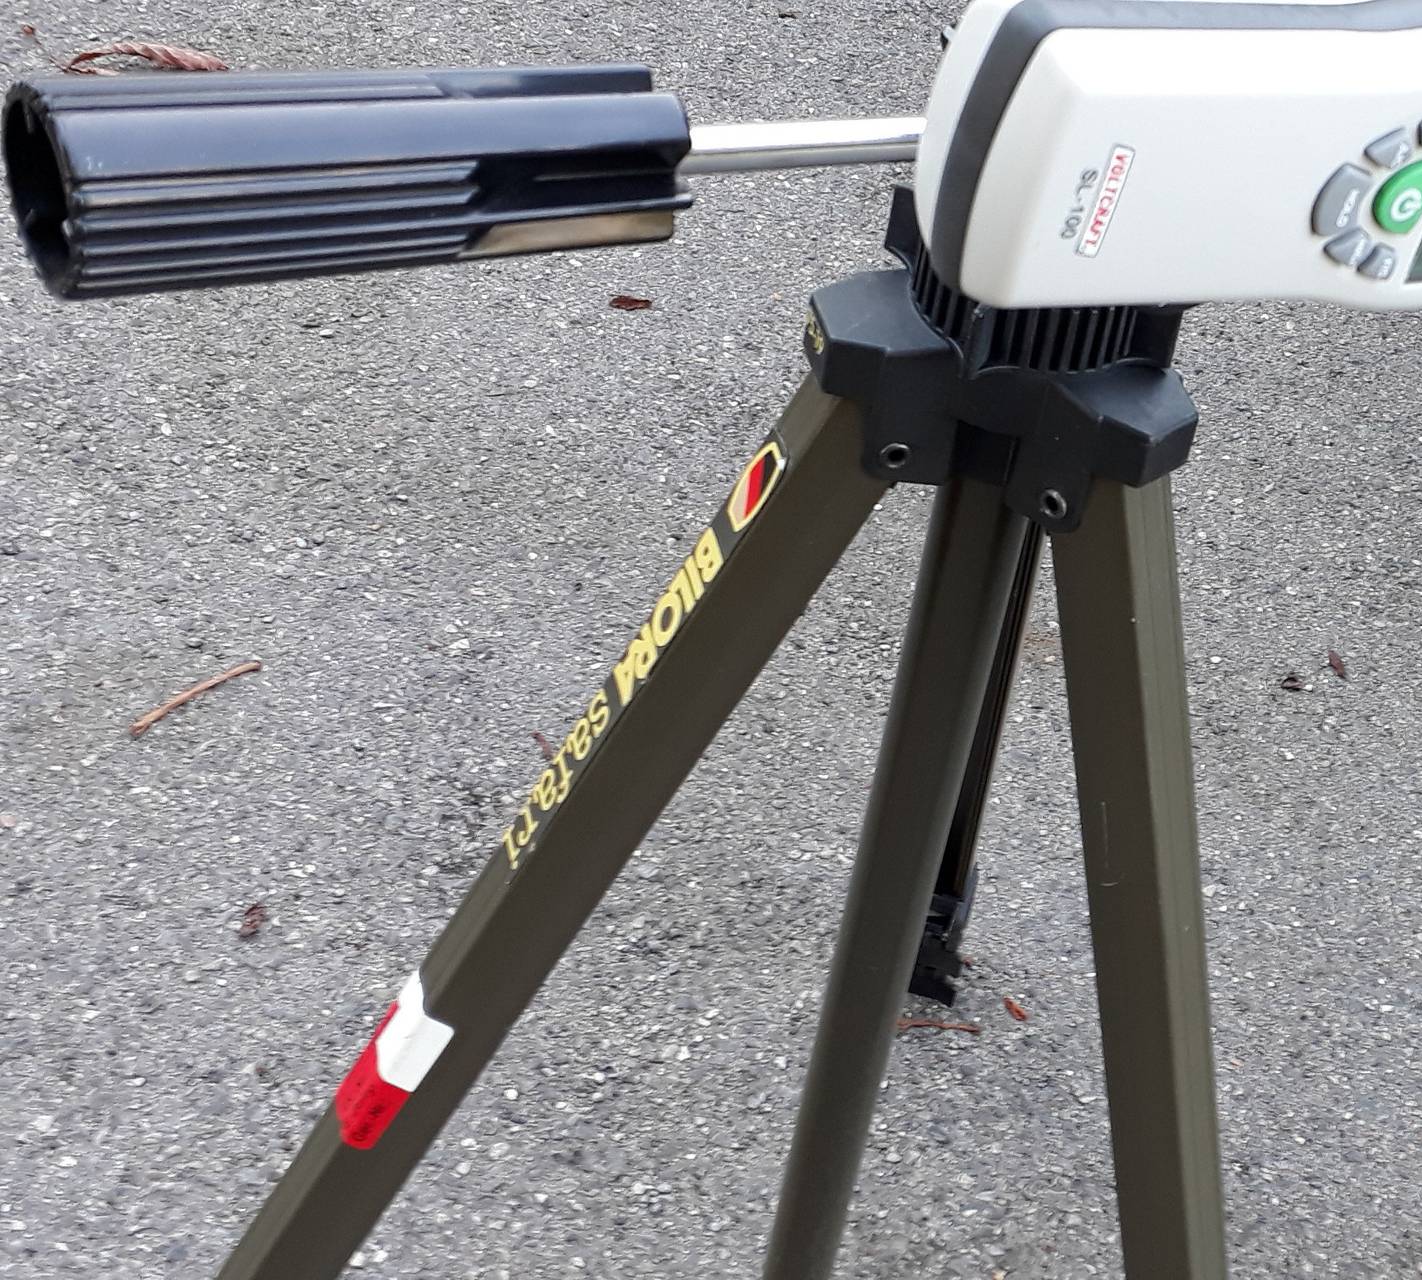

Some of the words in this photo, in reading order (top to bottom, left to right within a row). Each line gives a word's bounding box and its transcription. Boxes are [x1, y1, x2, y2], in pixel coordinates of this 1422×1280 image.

[1060, 169, 1098, 240] SL-100
[1085, 153, 1129, 246] VOLTCRAFT
[613, 527, 724, 707] BILORA
[502, 688, 609, 870] safari
